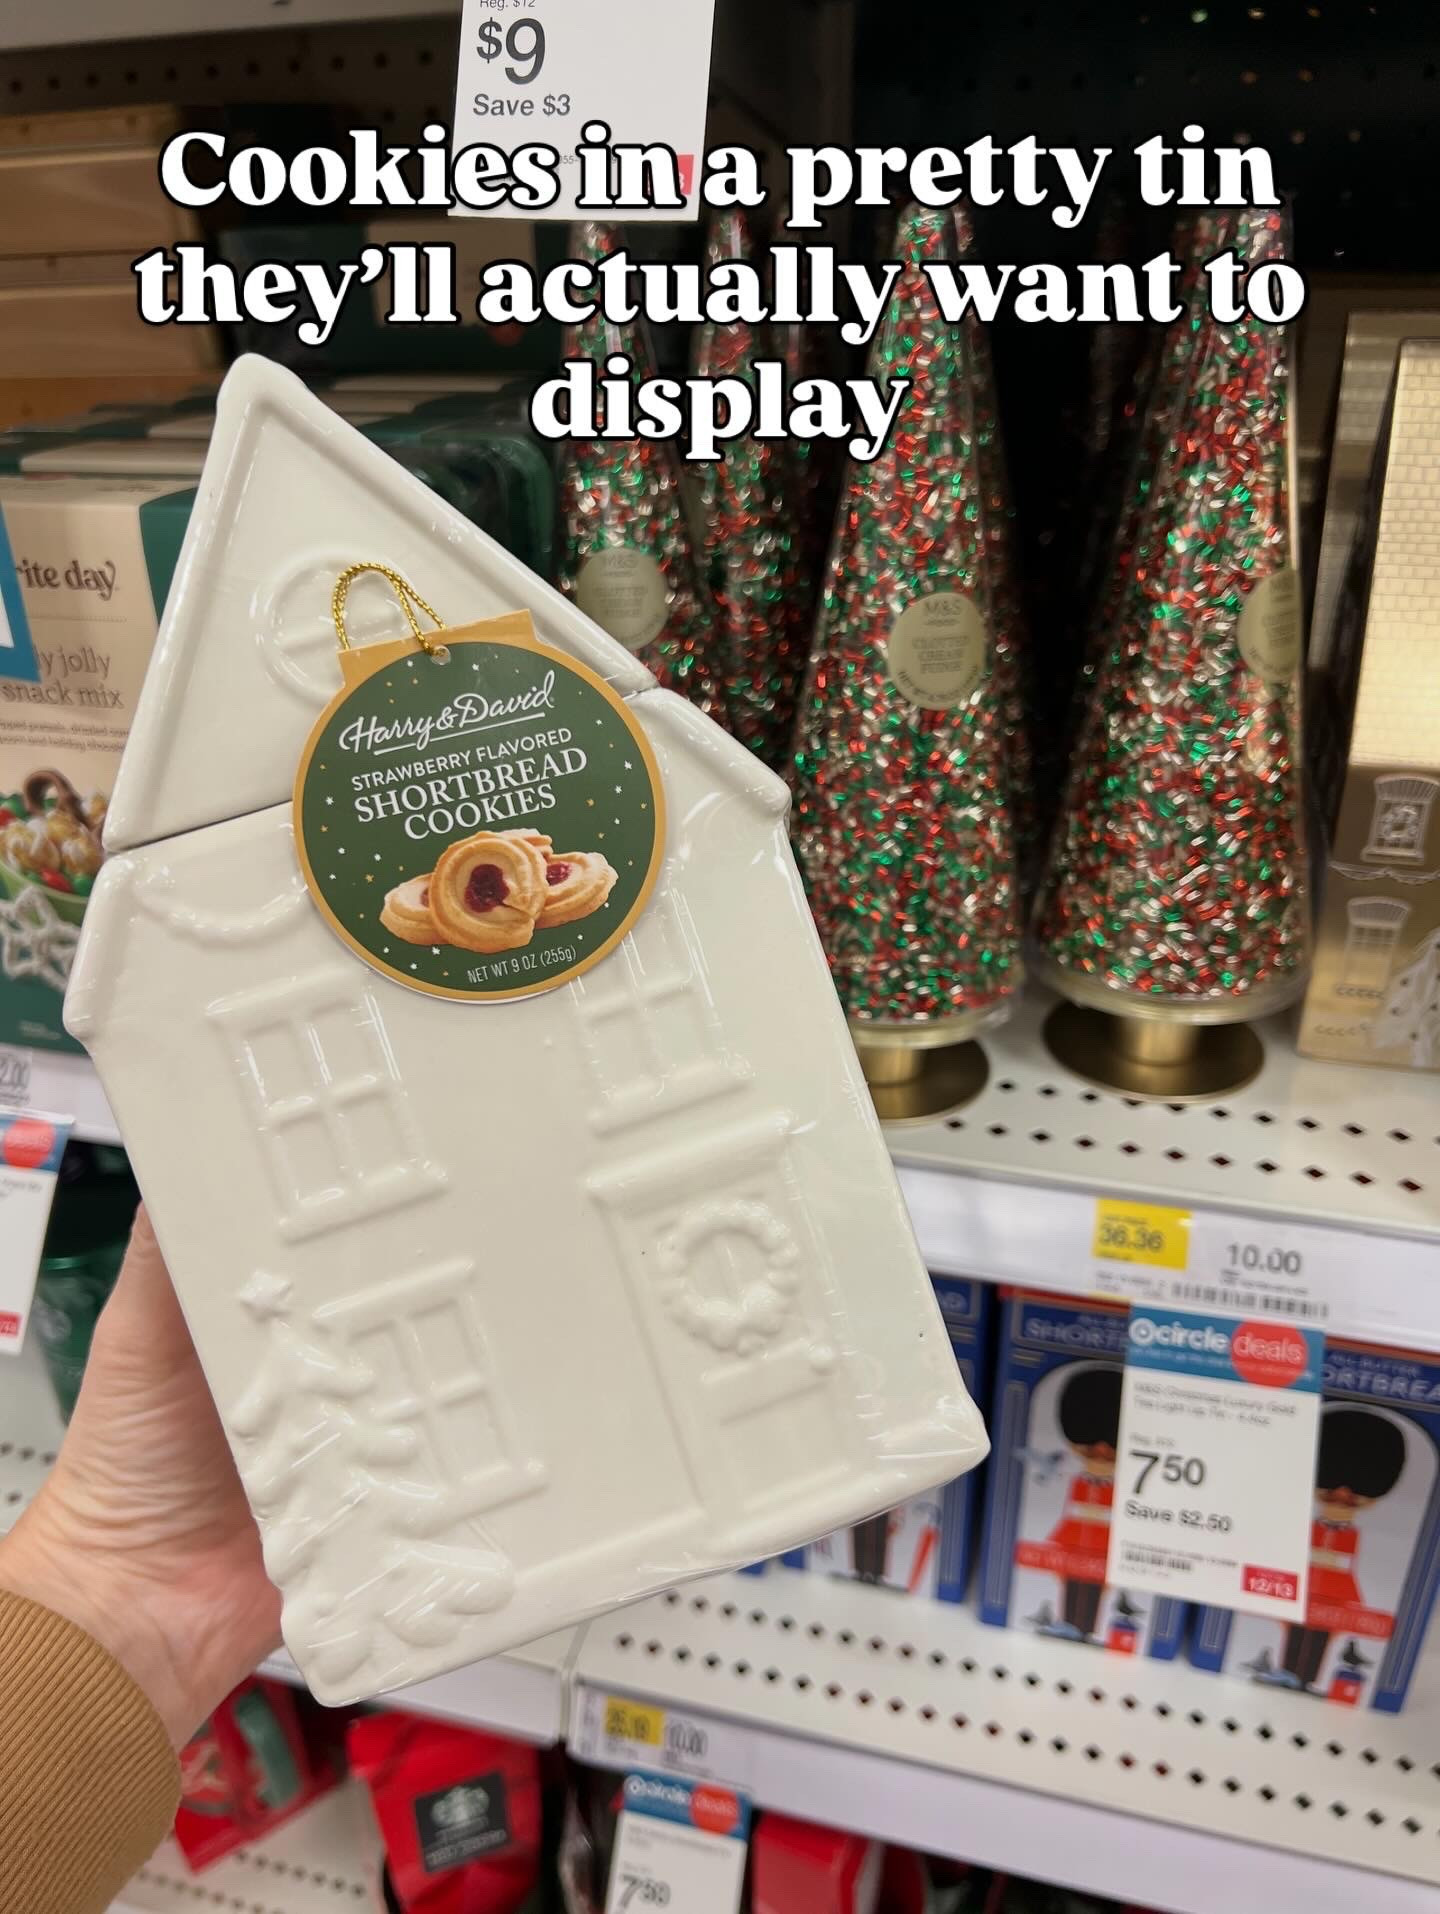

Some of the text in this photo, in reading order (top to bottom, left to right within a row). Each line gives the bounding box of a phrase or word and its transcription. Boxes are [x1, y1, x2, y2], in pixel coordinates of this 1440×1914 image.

[512, 0, 536, 9] $12
[476, 17, 546, 85] $9
[472, 92, 571, 117] Save $3
[64, 560, 116, 601] day
[59, 645, 110, 680] jolly
[1, 680, 125, 709] snack mix
[351, 727, 572, 792] STRAWBERRY FLAVORED
[354, 747, 588, 823] SHORTBREAD
[404, 783, 557, 840] COOKIES
[467, 944, 577, 984] NET WT 9 OZ (255g)
[1227, 1242, 1302, 1276] 10.00
[1153, 1321, 1230, 1354] circle
[1232, 1331, 1304, 1364] deals
[1124, 1500, 1233, 1534] Save $2.50
